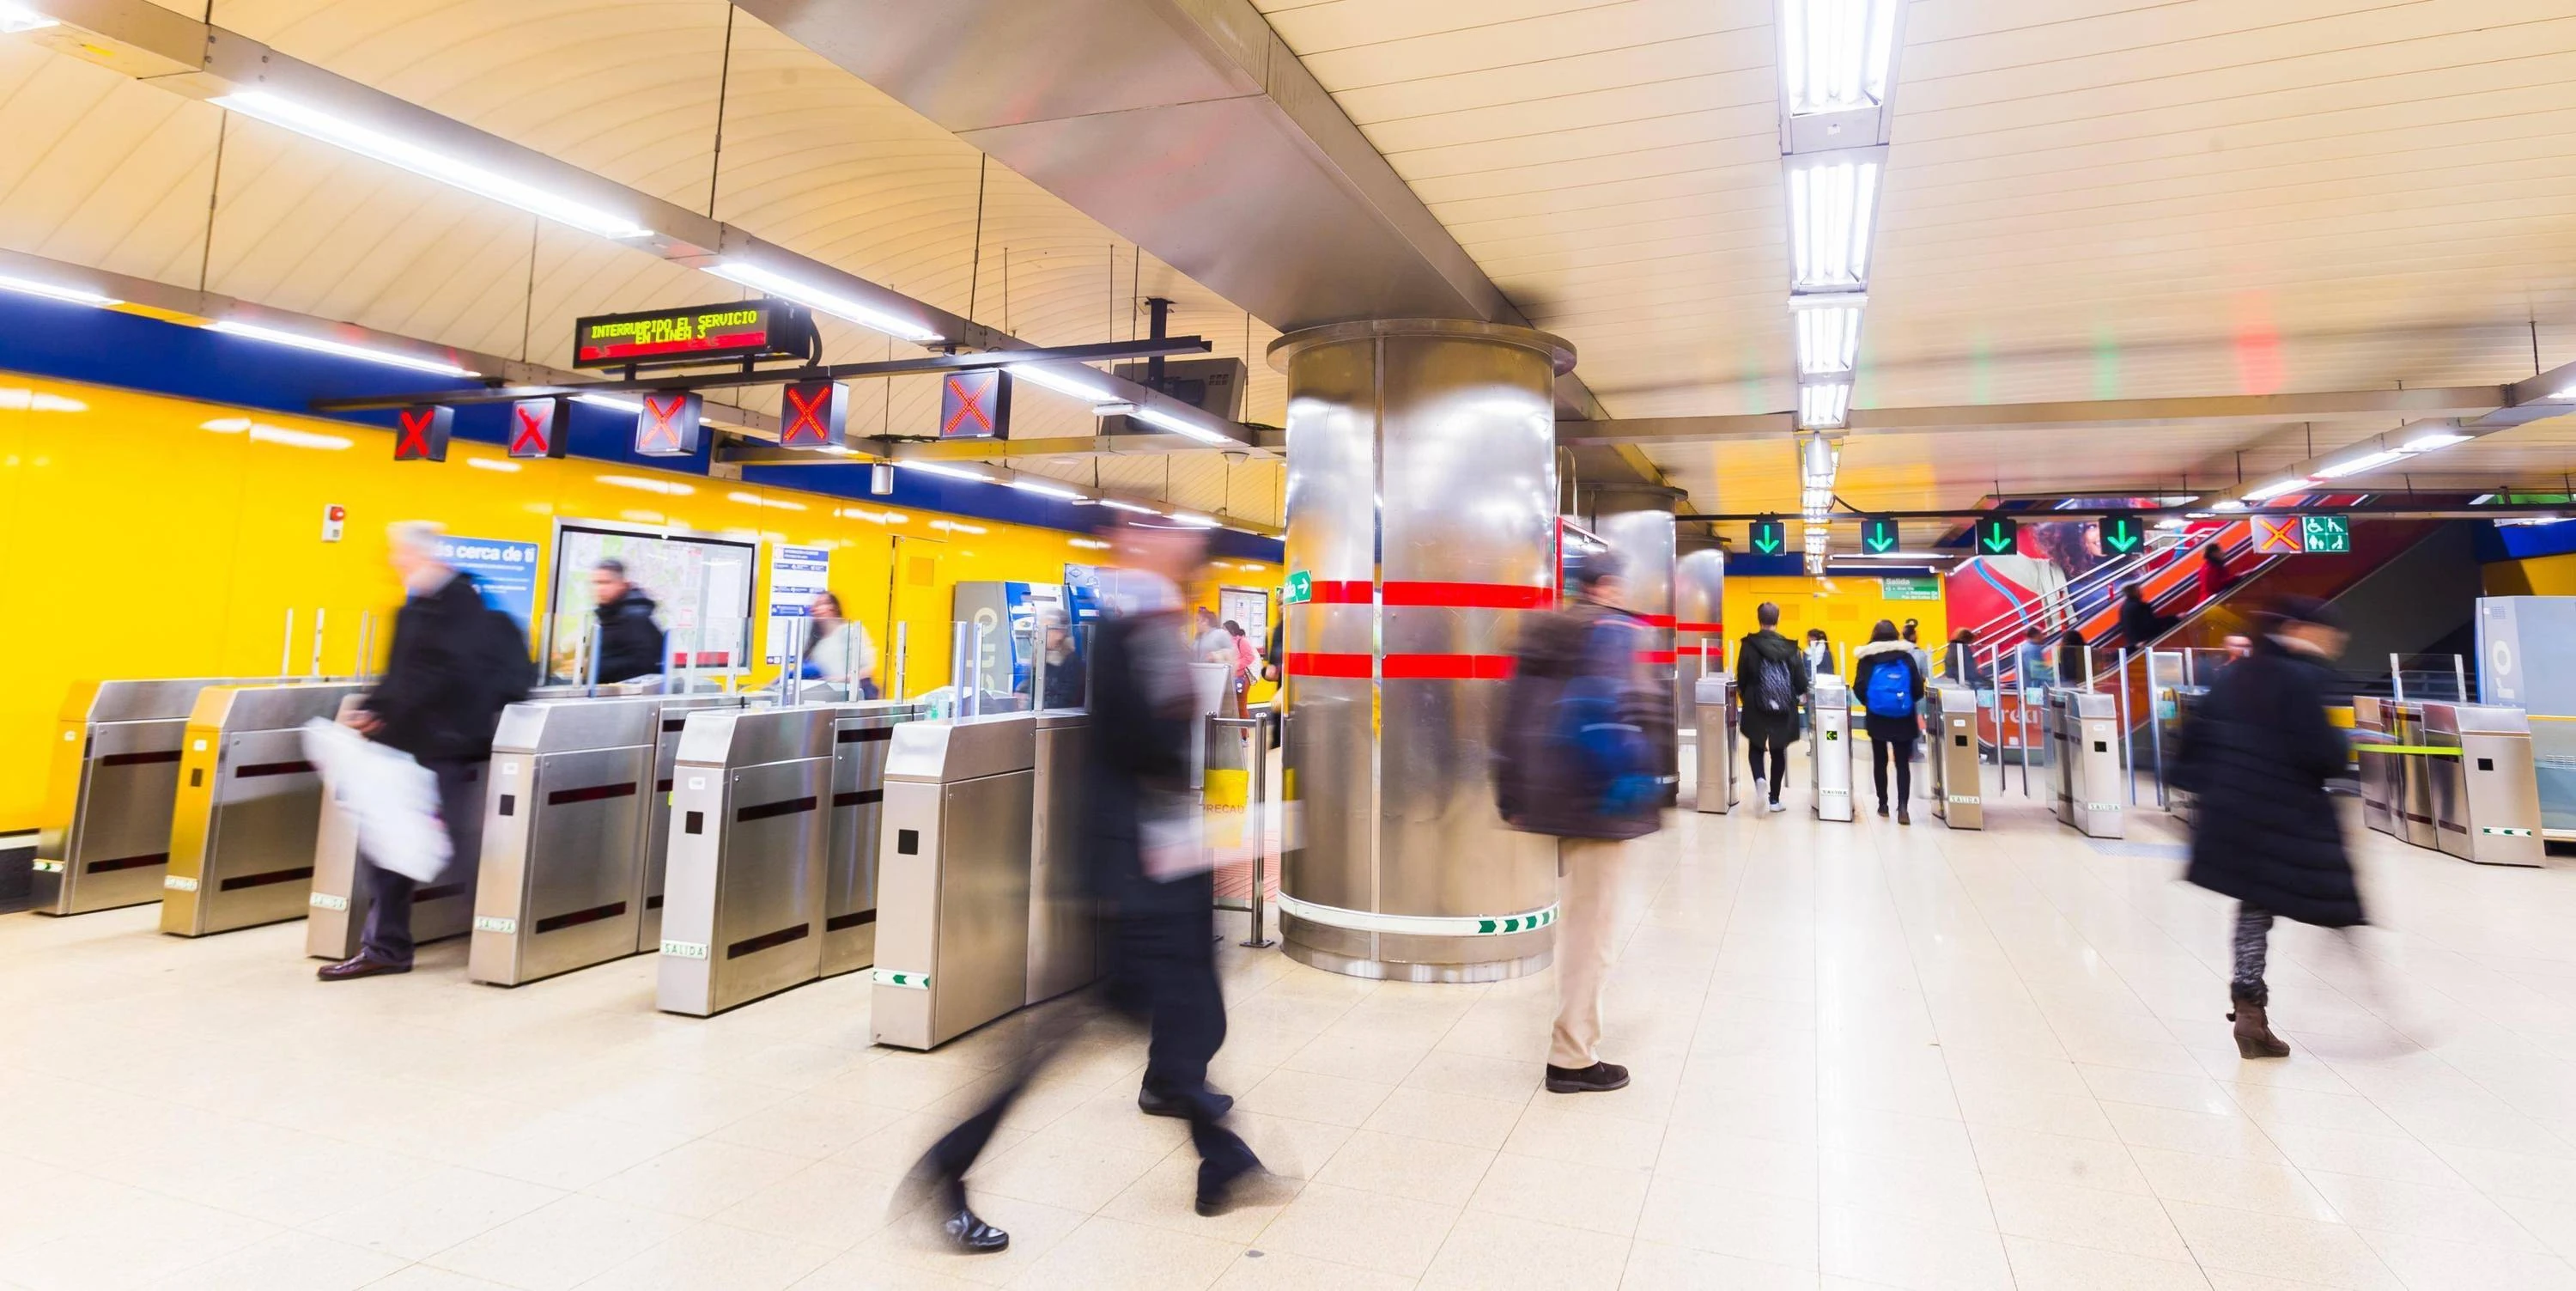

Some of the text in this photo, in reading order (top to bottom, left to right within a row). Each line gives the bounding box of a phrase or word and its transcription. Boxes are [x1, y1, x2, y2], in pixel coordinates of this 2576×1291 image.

[677, 316, 690, 331] EL
[698, 310, 757, 328] SERVICIO
[635, 332, 651, 345] EN
[697, 326, 707, 339] 3
[456, 545, 501, 561] cerca
[502, 545, 522, 562] de
[1886, 577, 1910, 586] Salida
[665, 942, 704, 956] SALIDA
